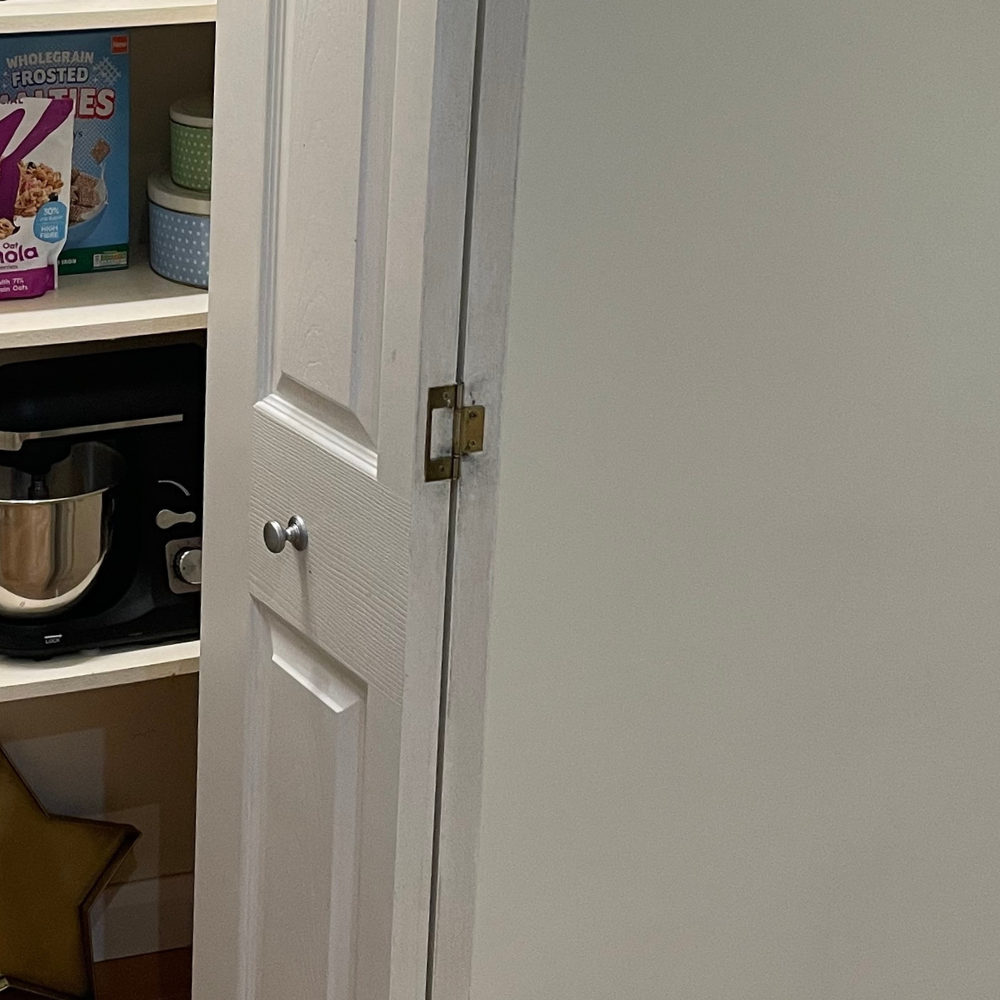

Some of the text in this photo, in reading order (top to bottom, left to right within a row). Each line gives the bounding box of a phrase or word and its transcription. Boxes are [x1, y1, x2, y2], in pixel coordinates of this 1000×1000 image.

[6, 51, 95, 69] WHOLEGRAIN
[11, 67, 89, 88] FROSTED
[43, 206, 60, 216] 30%
[40, 225, 59, 233] HIGH
[2, 241, 19, 250] Oat
[12, 284, 29, 292] Oats
